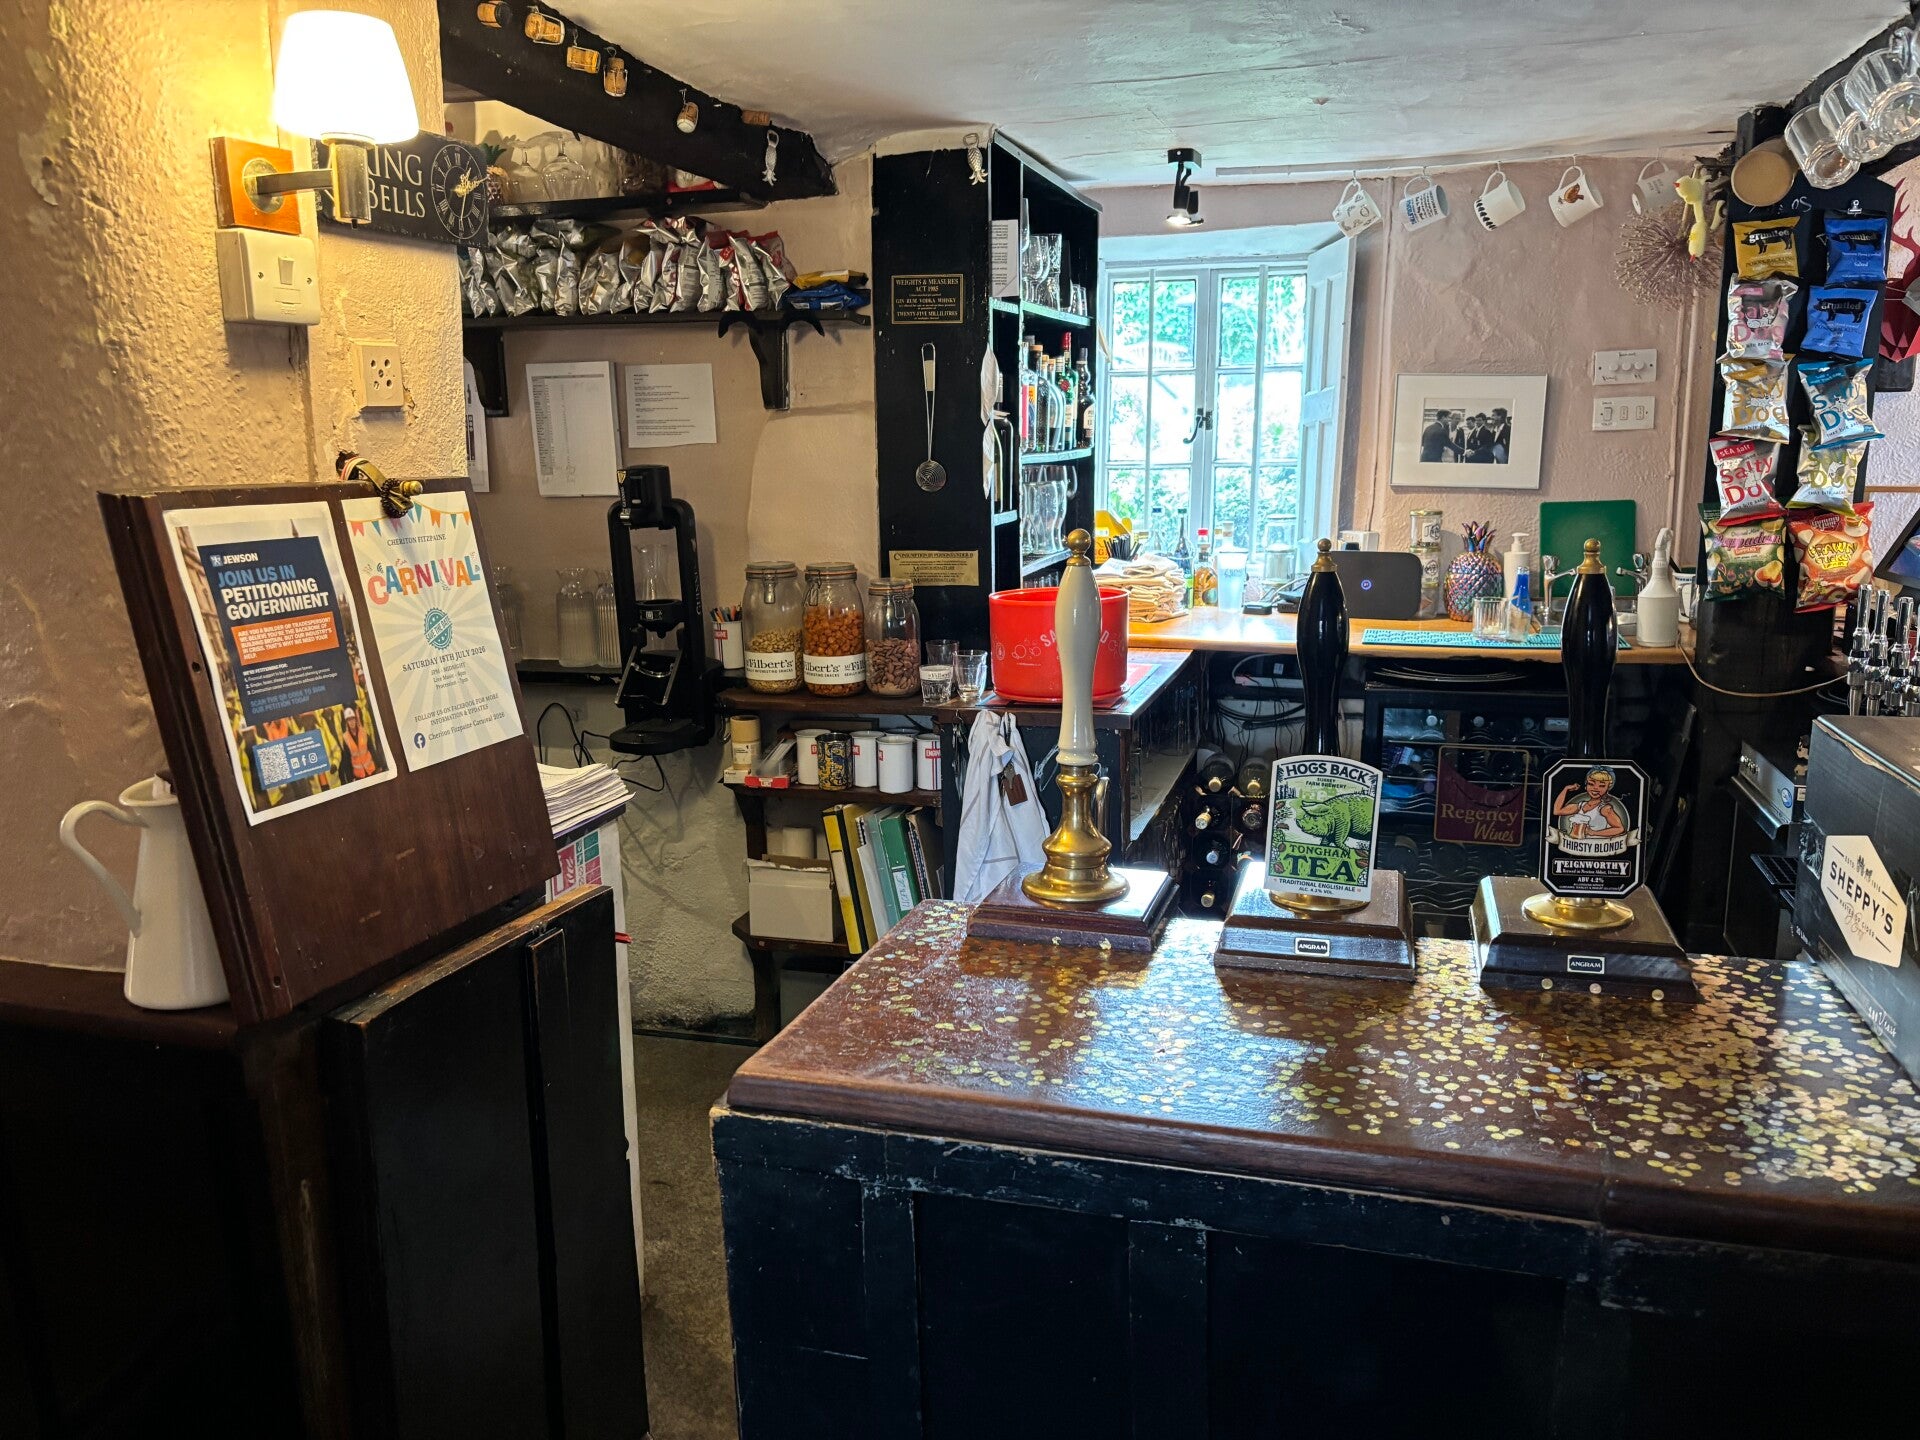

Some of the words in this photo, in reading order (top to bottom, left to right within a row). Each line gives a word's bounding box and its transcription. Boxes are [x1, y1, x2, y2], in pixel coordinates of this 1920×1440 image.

[367, 145, 422, 186] ING
[1720, 457, 1773, 483] Salty
[387, 537, 417, 546] CHERITON
[418, 534, 446, 543] FITZPAINE
[223, 553, 258, 564] JEWSON
[218, 569, 255, 588] JOIN
[257, 566, 278, 582] US
[279, 564, 296, 580] IN
[368, 556, 480, 605] CARNIVAL
[220, 578, 318, 604] PETITIONING
[226, 592, 329, 620] GOVERNMENT
[402, 657, 441, 672] SATURDAY
[455, 649, 470, 661] JULY
[471, 645, 486, 656] 2026
[749, 658, 793, 668] Filbert's
[414, 711, 438, 722] FOLLOW
[451, 699, 475, 712] FACEBOOK
[485, 693, 499, 701] MORE
[430, 712, 463, 725] INFORMATION
[468, 704, 489, 714] UPDATES
[1286, 763, 1327, 776] HOGS
[1330, 764, 1369, 784] BACK
[1441, 803, 1518, 826] Regency
[1474, 821, 1514, 842] Wines
[1289, 844, 1351, 858] TONGHAM
[1562, 840, 1593, 853] THIRSTY
[1594, 840, 1624, 853] BLONDE
[1283, 854, 1356, 885] TEA
[1554, 860, 1630, 875] TEIGNWORTHY
[1280, 879, 1317, 888] TRADITIONAL
[1318, 882, 1344, 890] ENGLISH
[1830, 861, 1894, 935] SHEPPY'S
